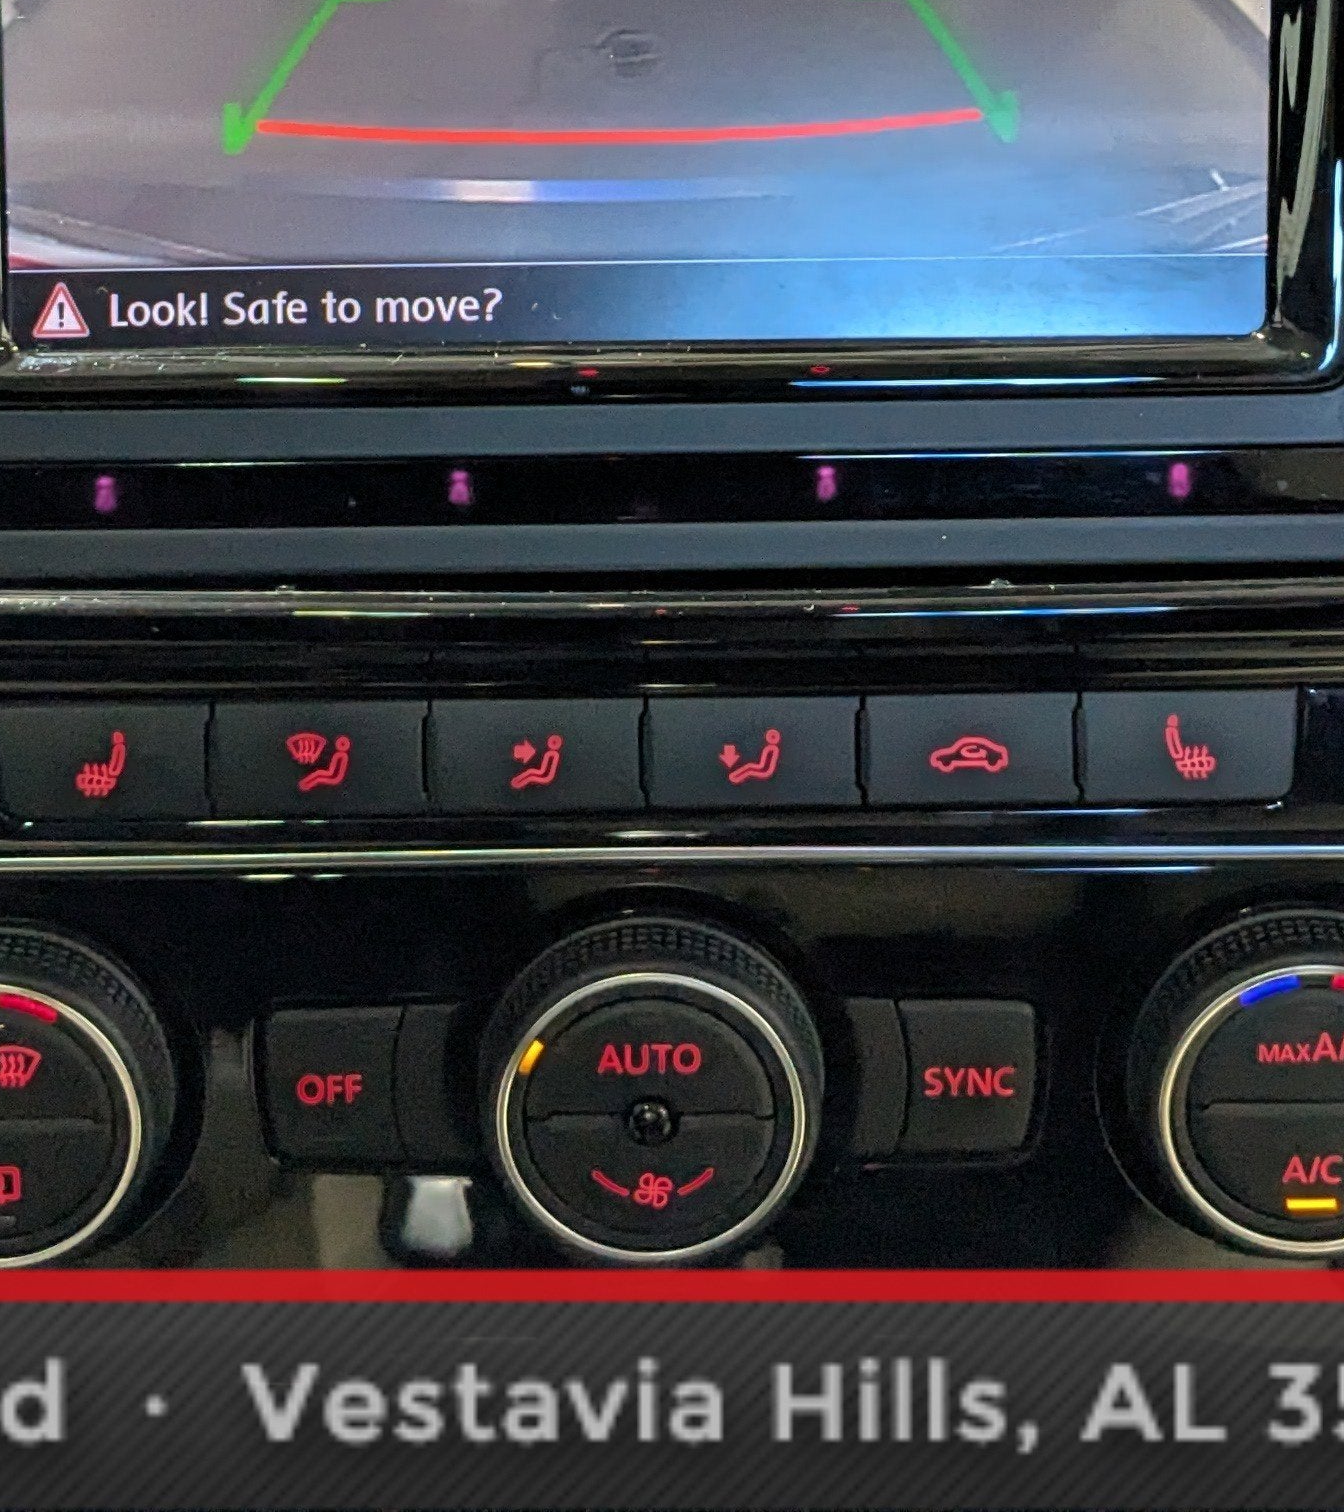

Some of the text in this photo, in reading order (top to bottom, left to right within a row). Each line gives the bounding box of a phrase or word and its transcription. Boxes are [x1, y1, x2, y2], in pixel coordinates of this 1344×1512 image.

[108, 287, 504, 328] Look! Safe to move?
[597, 1042, 702, 1076] AUTO
[295, 1073, 363, 1106] OFF
[923, 1066, 1016, 1099] SYNC
[1281, 1154, 1344, 1186] A/C
